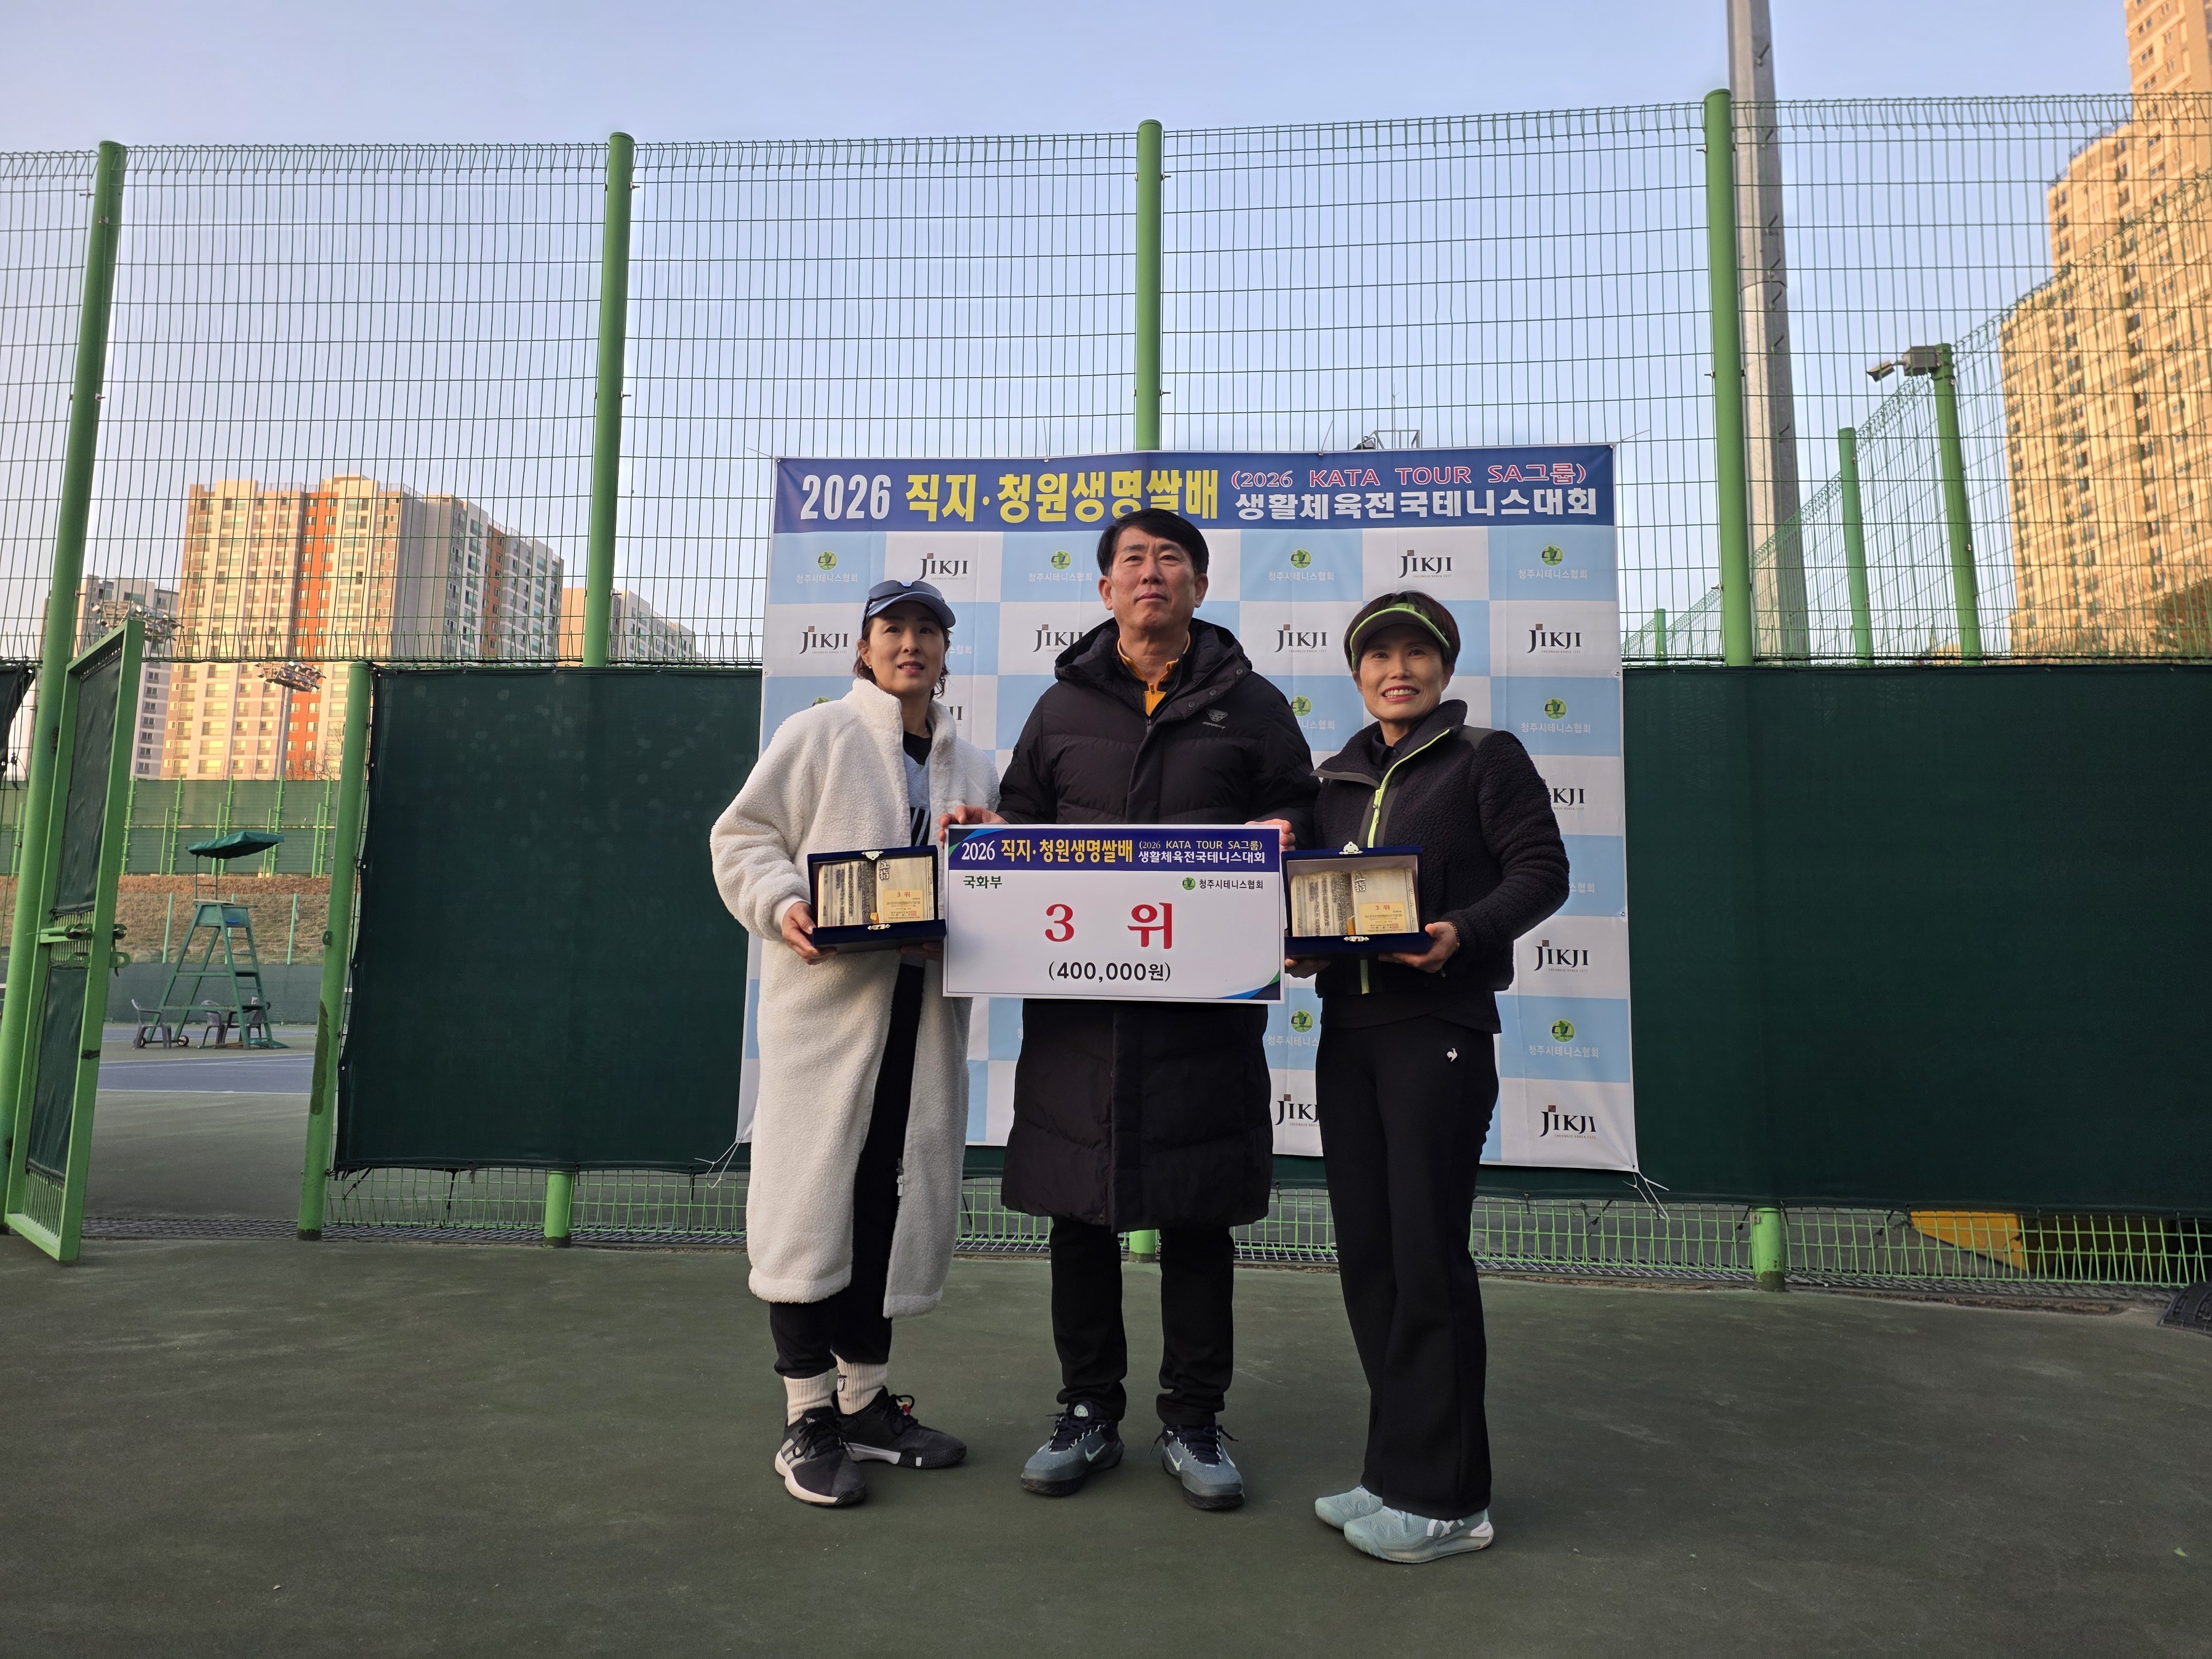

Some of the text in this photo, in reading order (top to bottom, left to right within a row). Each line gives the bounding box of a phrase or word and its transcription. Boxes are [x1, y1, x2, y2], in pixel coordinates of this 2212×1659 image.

[1230, 463, 1587, 491] (2026 KATA TOUR SA그룹)
[800, 474, 892, 520] 2026
[1235, 488, 1597, 521] 생활체육전국테니스대회
[918, 559, 968, 580] JIKJI
[1028, 572, 1092, 582] 청주시테니스협회
[1268, 571, 1334, 581] 청주시테니스협회
[1399, 556, 1452, 578] JIKJI
[1518, 569, 1587, 579] 청주시테니스협회
[796, 573, 858, 583] 청주시테니스협회
[799, 632, 848, 654] JIKJI
[1274, 630, 1327, 653] JIKJI
[1527, 630, 1582, 653] JIKJI
[1521, 722, 1591, 733] 청주시테니스협회
[1549, 788, 1585, 806] KJI
[961, 839, 1133, 863] 2026 직지·청원생명쌀배
[1139, 841, 1262, 851] (2026 KATA TOUR SA그룹)
[1138, 851, 1265, 863] 생활체육전국테니스대회
[963, 875, 1003, 889] 국화부
[1199, 879, 1263, 889] 청주시테니스협회
[1045, 902, 1173, 950] 3 위
[1533, 946, 1589, 971] JIKJI
[1048, 962, 1171, 983] (400,000원)
[1267, 1035, 1318, 1047] 청주시테니스
[1528, 1045, 1599, 1058] 청주시테니스협회
[1275, 1100, 1319, 1126] JIKJ
[1539, 1112, 1597, 1137] JIKJI
